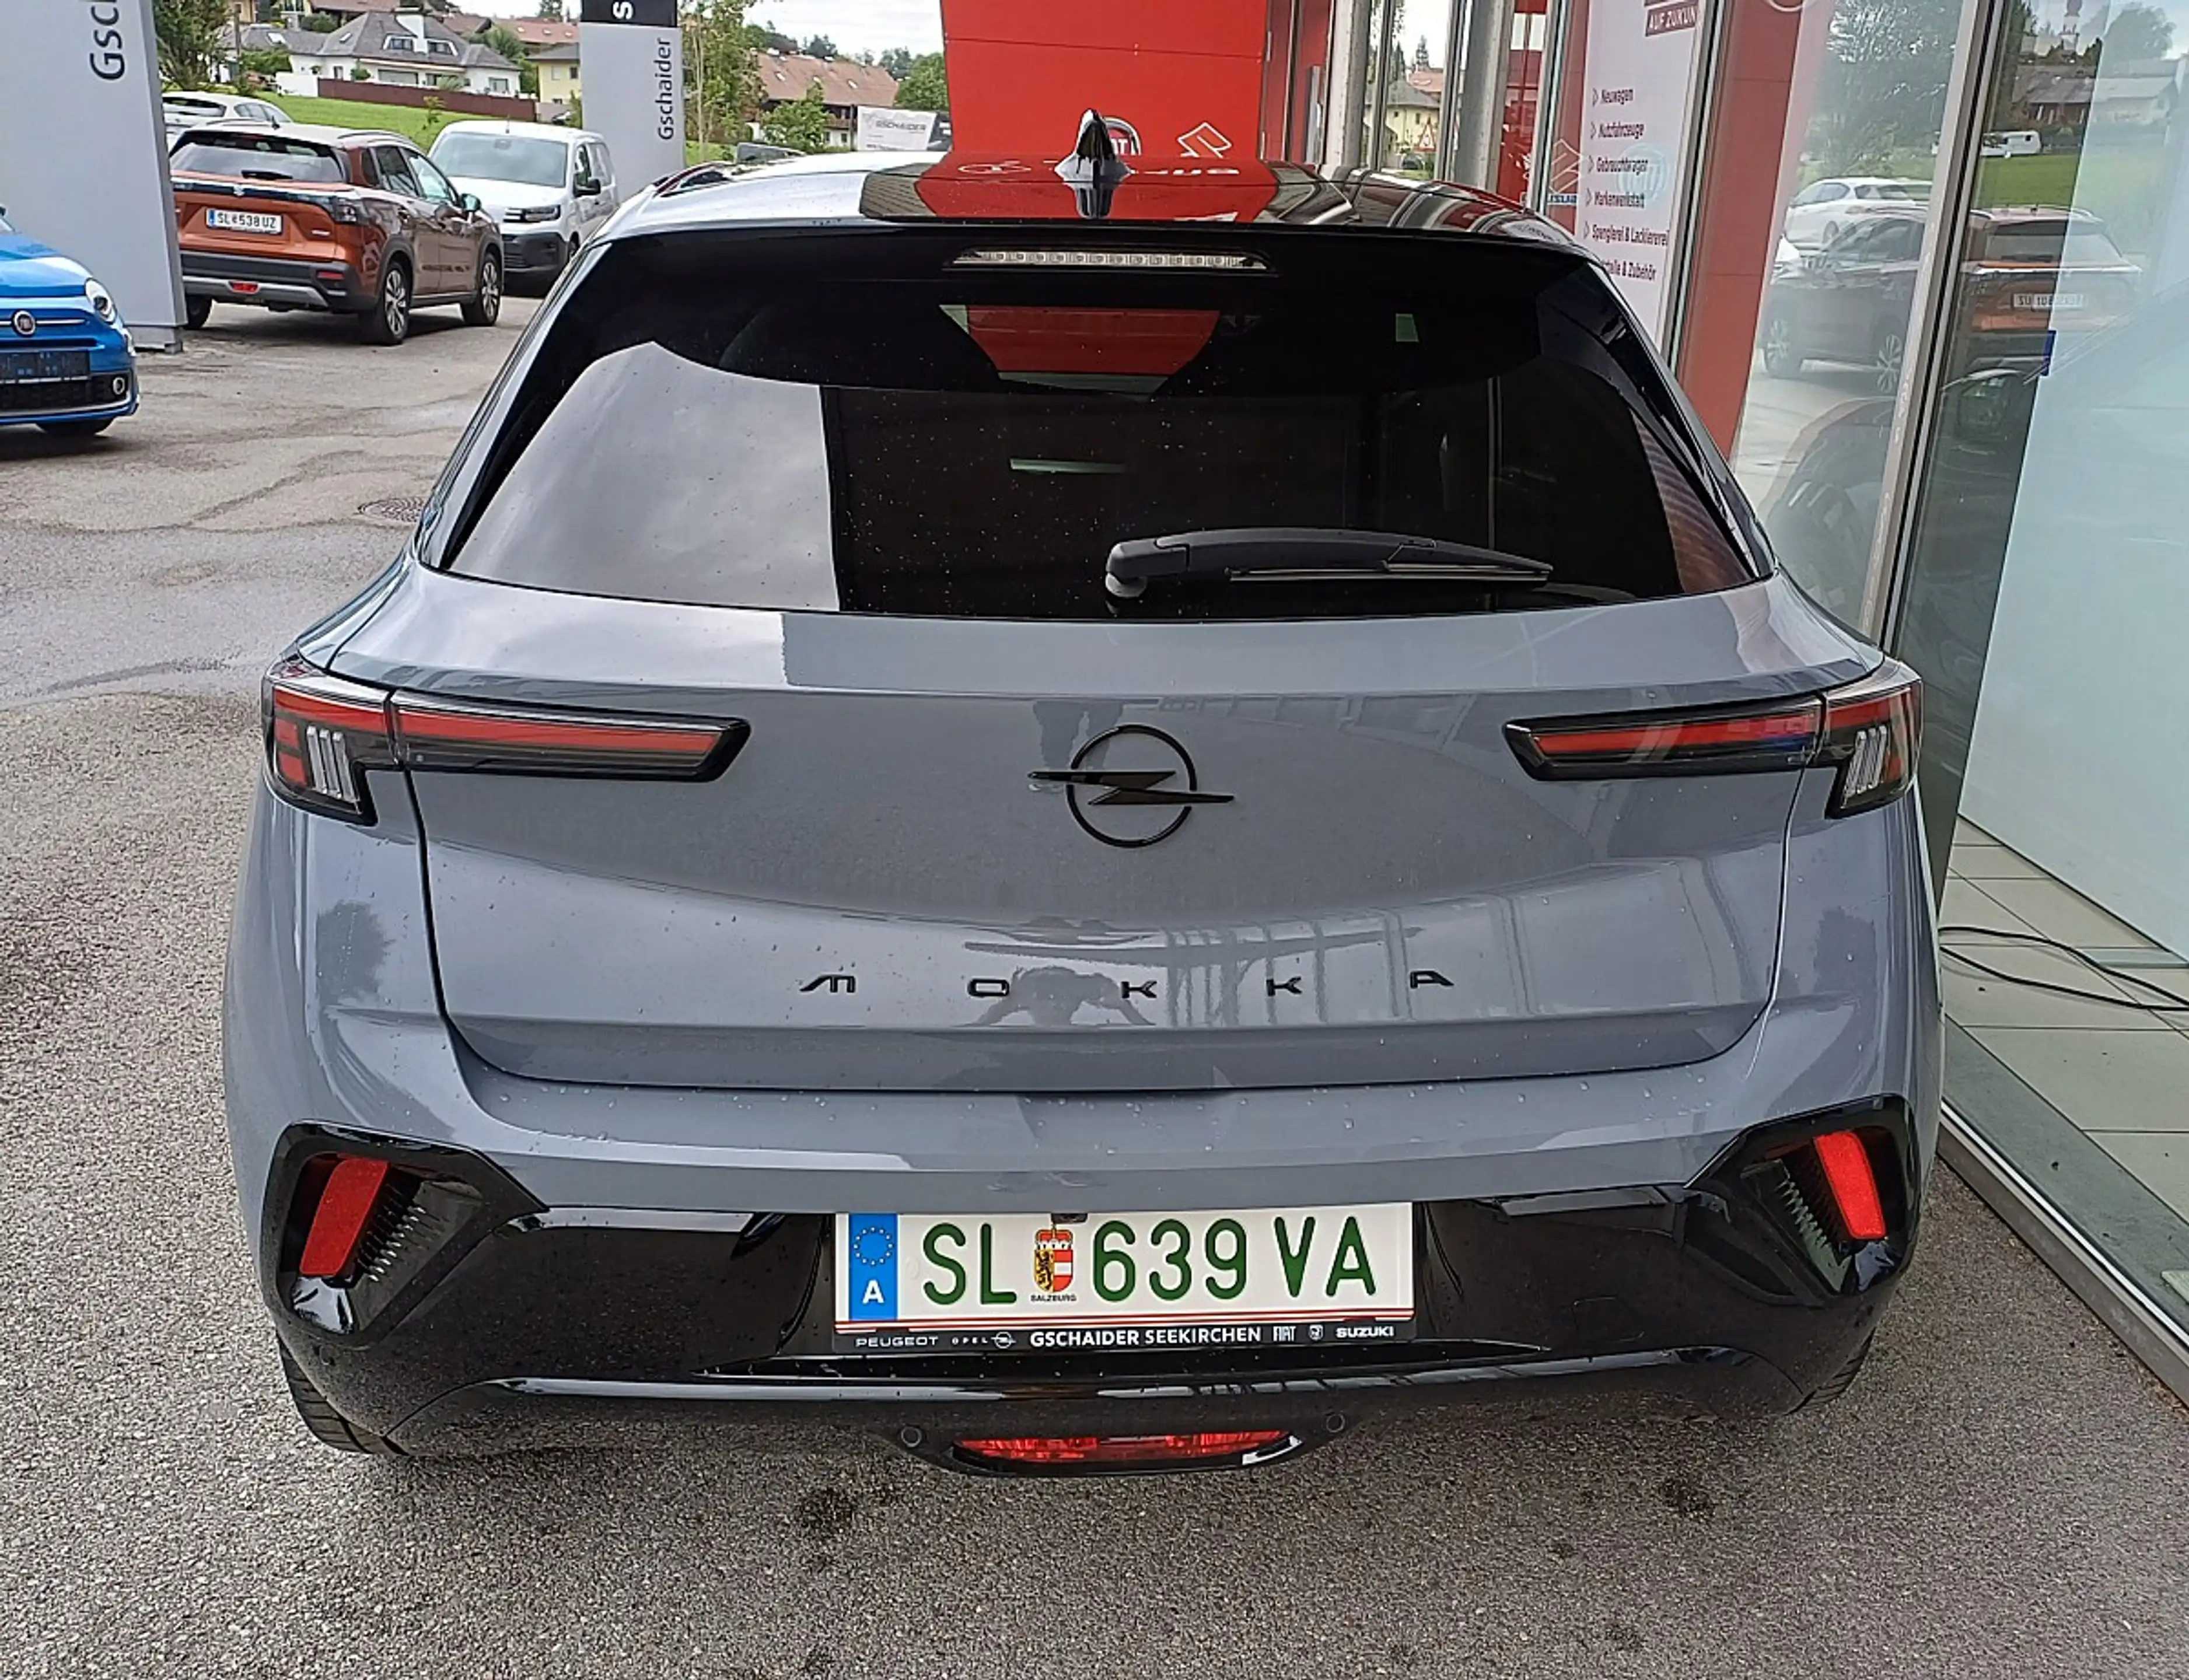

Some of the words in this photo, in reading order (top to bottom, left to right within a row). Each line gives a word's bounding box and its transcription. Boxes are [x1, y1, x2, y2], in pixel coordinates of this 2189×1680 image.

[82, 0, 125, 80] Gsc
[653, 37, 674, 140] Gschaider
[799, 969, 1455, 999] MOKKA
[923, 1223, 1017, 1305] SL
[1093, 1218, 1247, 1302] 639
[1274, 1216, 1376, 1297] VA
[862, 1279, 884, 1304] A
[1030, 1294, 1077, 1302] SALZBURG
[855, 1336, 939, 1348] PEUGEOT
[952, 1336, 988, 1345] OPEL
[1030, 1329, 1139, 1347] GSCHAIDER
[1145, 1326, 1261, 1344] SEEKIRCHEN
[1273, 1325, 1296, 1342] FIAT
[1336, 1326, 1394, 1338] SUZUKI
